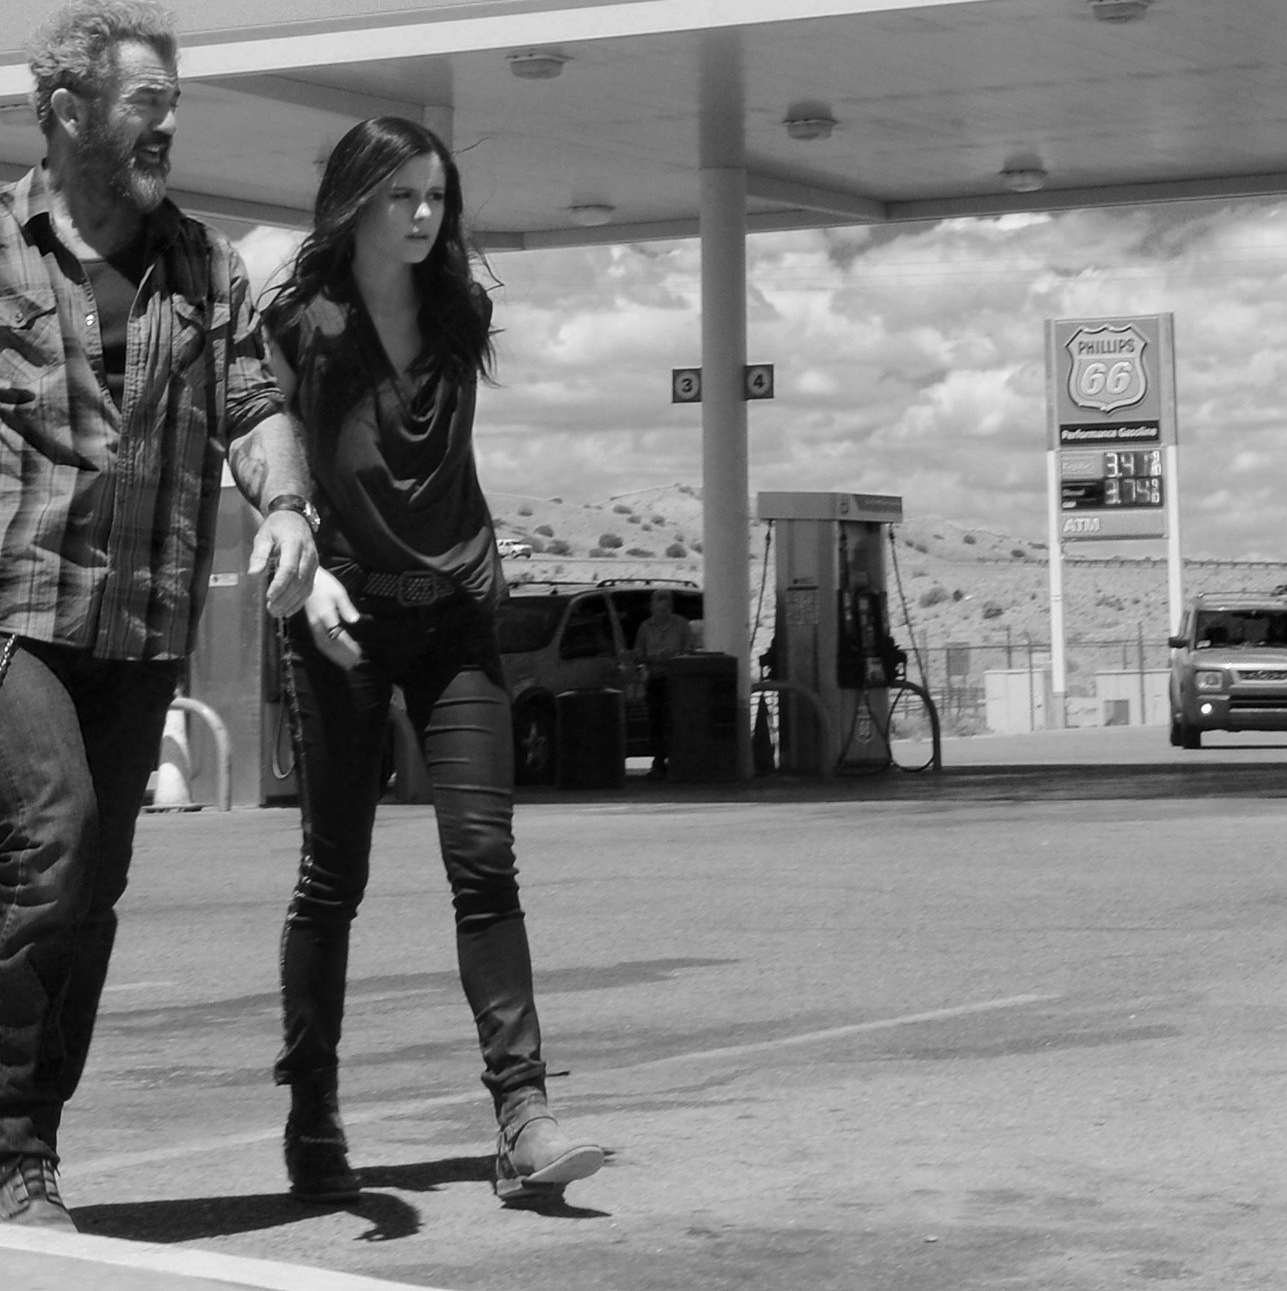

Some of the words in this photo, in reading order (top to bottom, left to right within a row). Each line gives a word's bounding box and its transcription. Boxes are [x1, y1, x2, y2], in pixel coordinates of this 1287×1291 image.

[1078, 338, 1135, 356] PHILLIPS
[681, 377, 694, 393] 3
[753, 373, 765, 389] 4
[1080, 361, 1133, 396] 66
[1062, 516, 1101, 533] ATM
